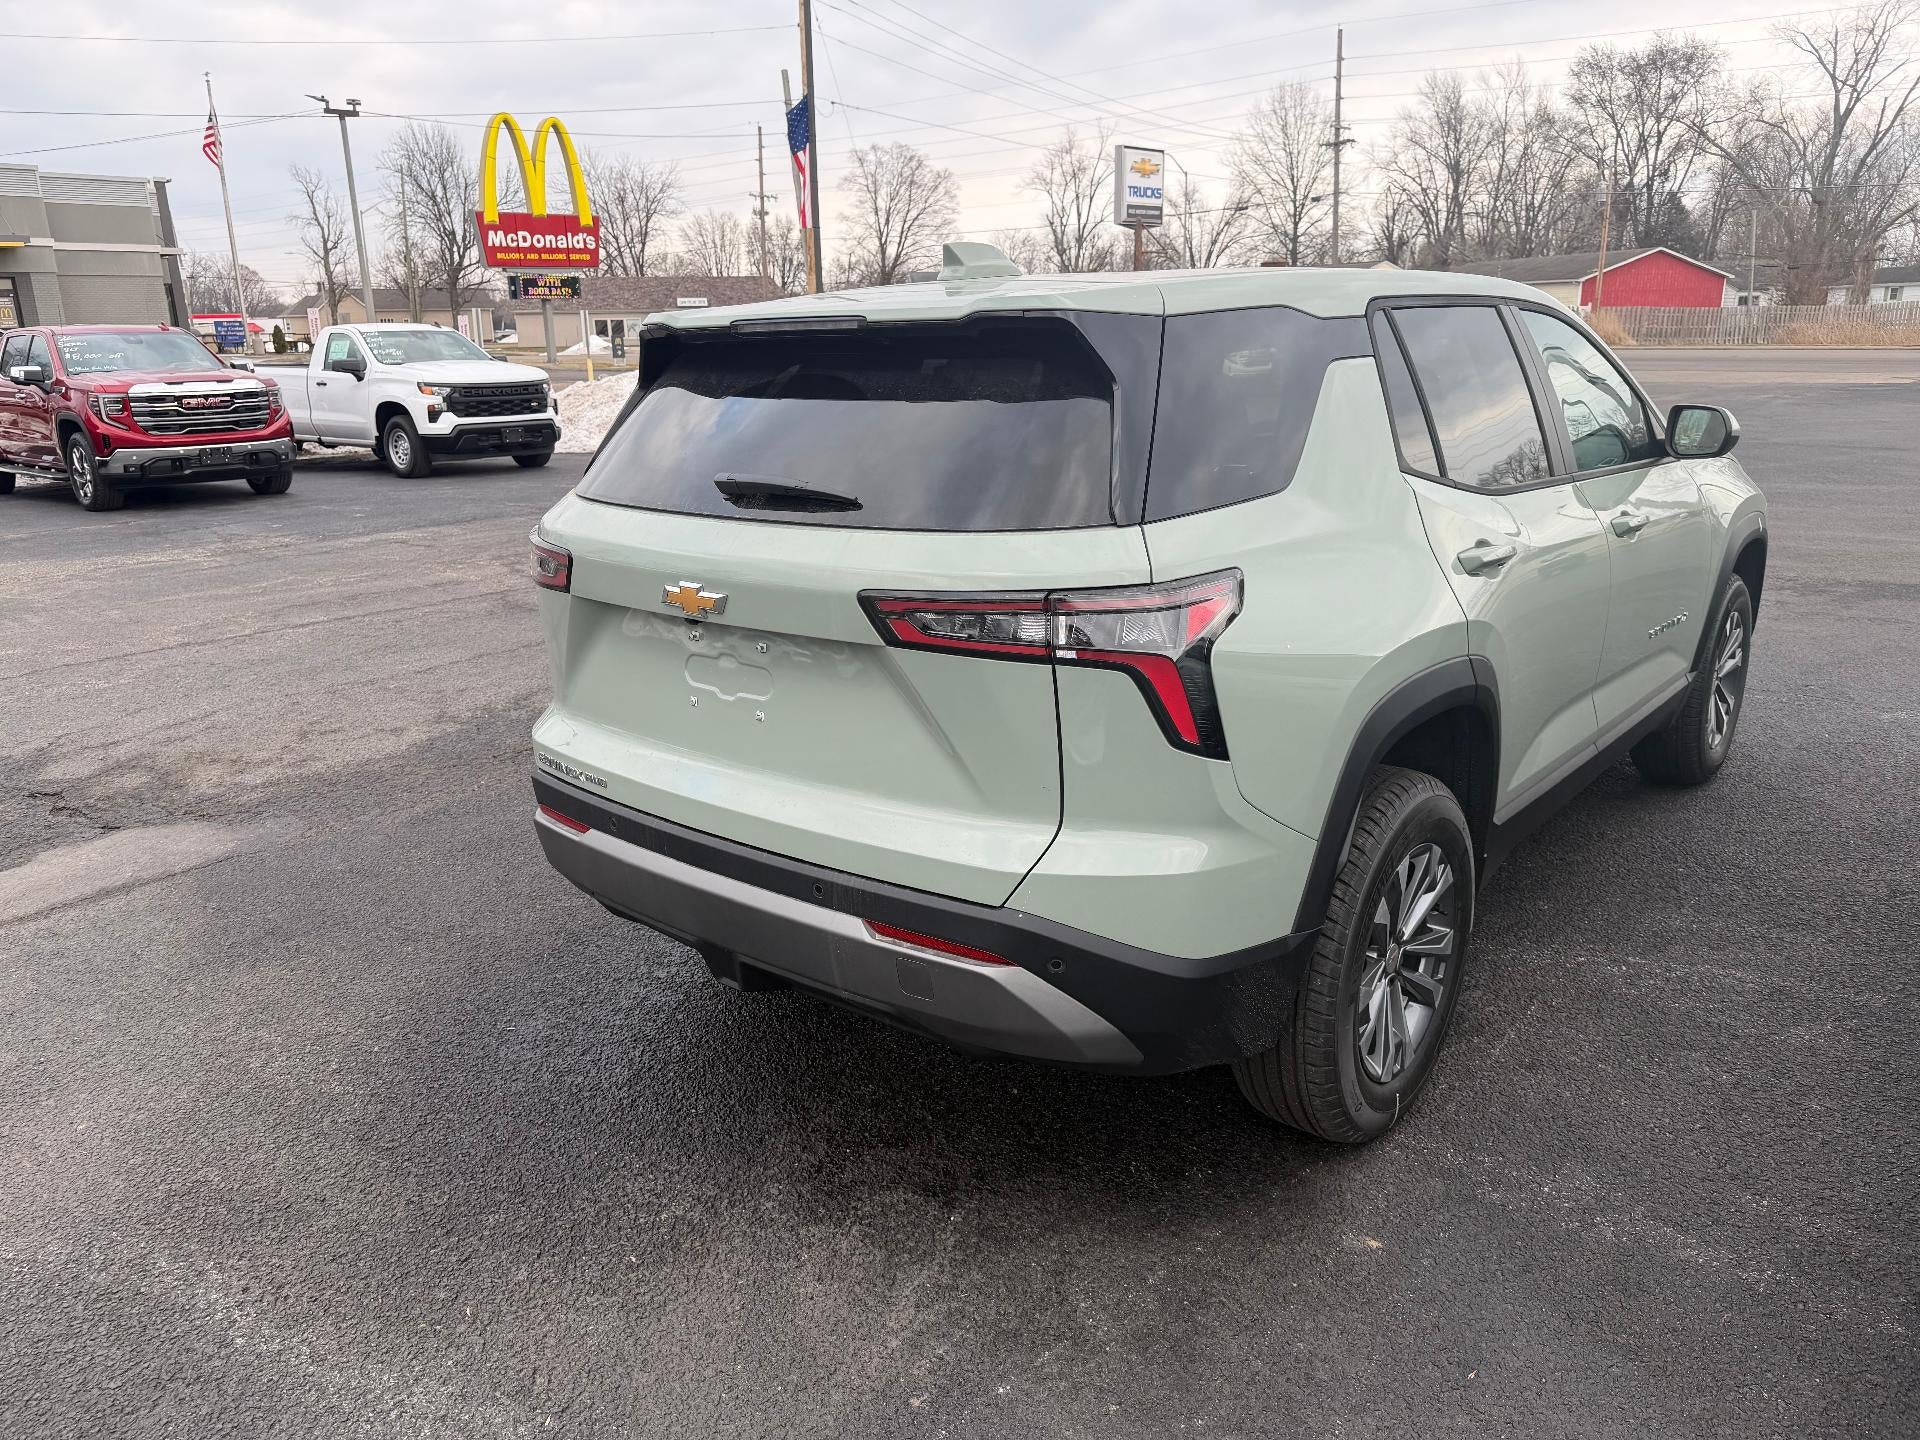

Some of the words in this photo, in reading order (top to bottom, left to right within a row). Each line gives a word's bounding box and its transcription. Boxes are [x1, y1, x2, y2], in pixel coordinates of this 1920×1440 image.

[1128, 185, 1162, 199] TRUCKS
[487, 230, 596, 250] McDonald's
[496, 252, 524, 260] BILLIONS
[569, 253, 591, 261] SERVED
[537, 278, 561, 287] WITH
[528, 287, 550, 295] DOOR
[182, 397, 231, 408] GMC
